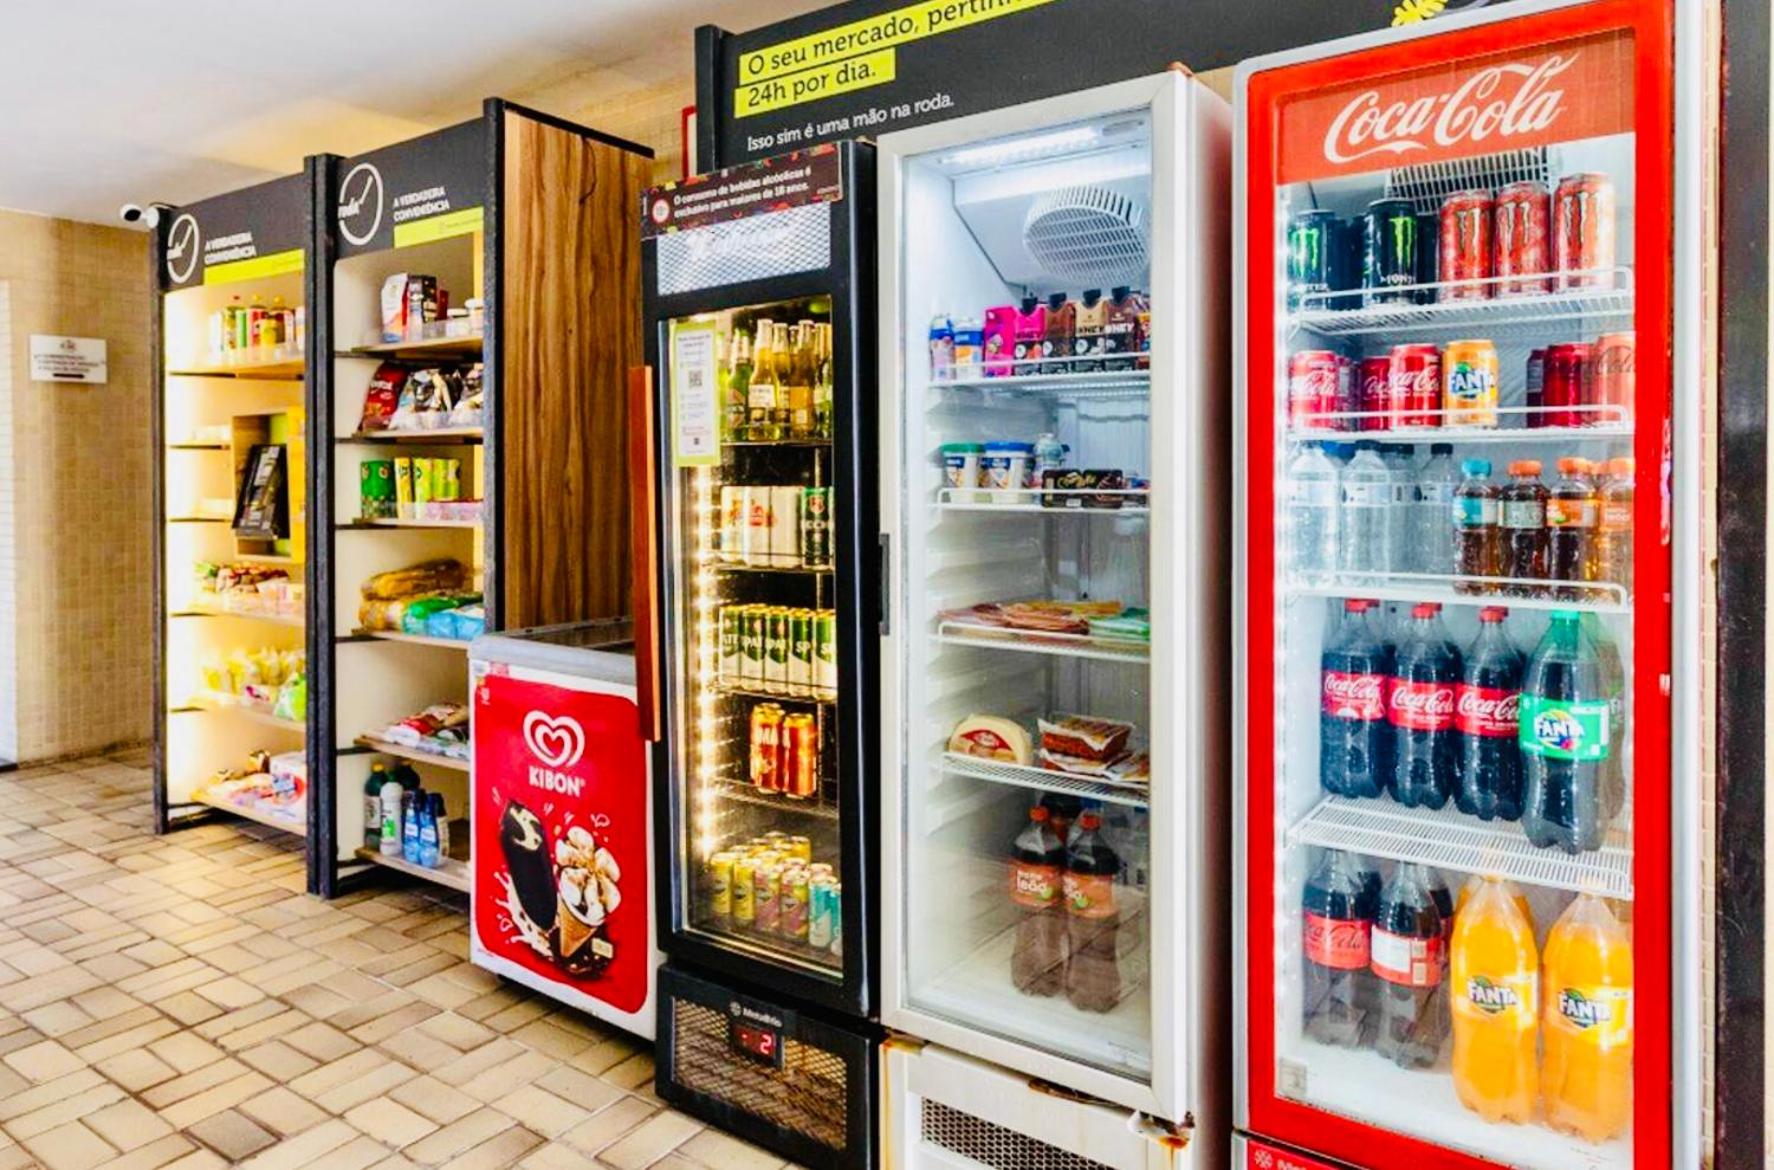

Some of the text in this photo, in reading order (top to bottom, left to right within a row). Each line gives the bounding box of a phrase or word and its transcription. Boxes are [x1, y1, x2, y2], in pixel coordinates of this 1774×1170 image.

[748, 55, 764, 75] O
[771, 47, 807, 70] seu
[813, 16, 919, 58] mercado,
[748, 61, 876, 107] 24h por dia.
[747, 93, 955, 151] Isso sim é uma mão na roda.
[1323, 52, 1580, 165] Coca-Cola
[528, 764, 581, 798] KIBON
[1467, 980, 1516, 1005] FANTA
[1559, 991, 1611, 1021] FANTA
